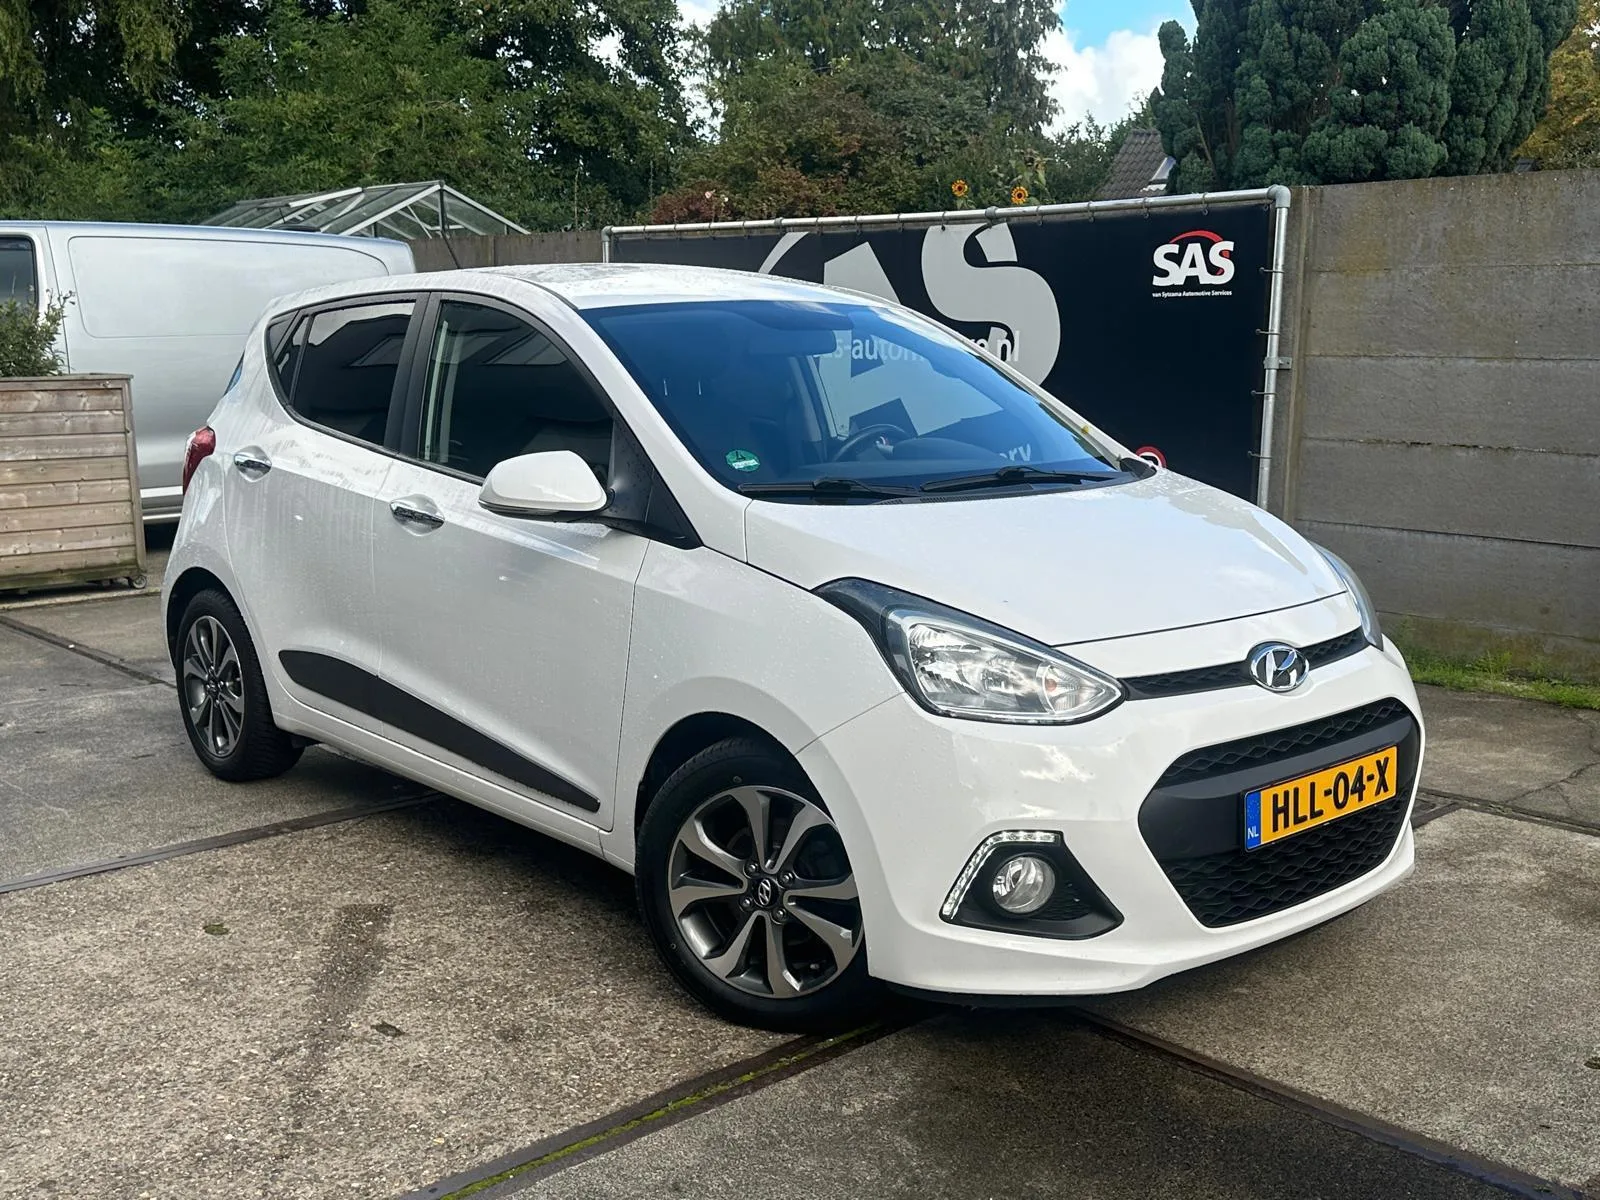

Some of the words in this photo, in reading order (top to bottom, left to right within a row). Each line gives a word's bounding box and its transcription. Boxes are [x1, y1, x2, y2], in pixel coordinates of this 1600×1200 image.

[1152, 241, 1235, 286] SAS
[1272, 756, 1390, 833] HLL-04-X
[1247, 826, 1260, 840] NL
